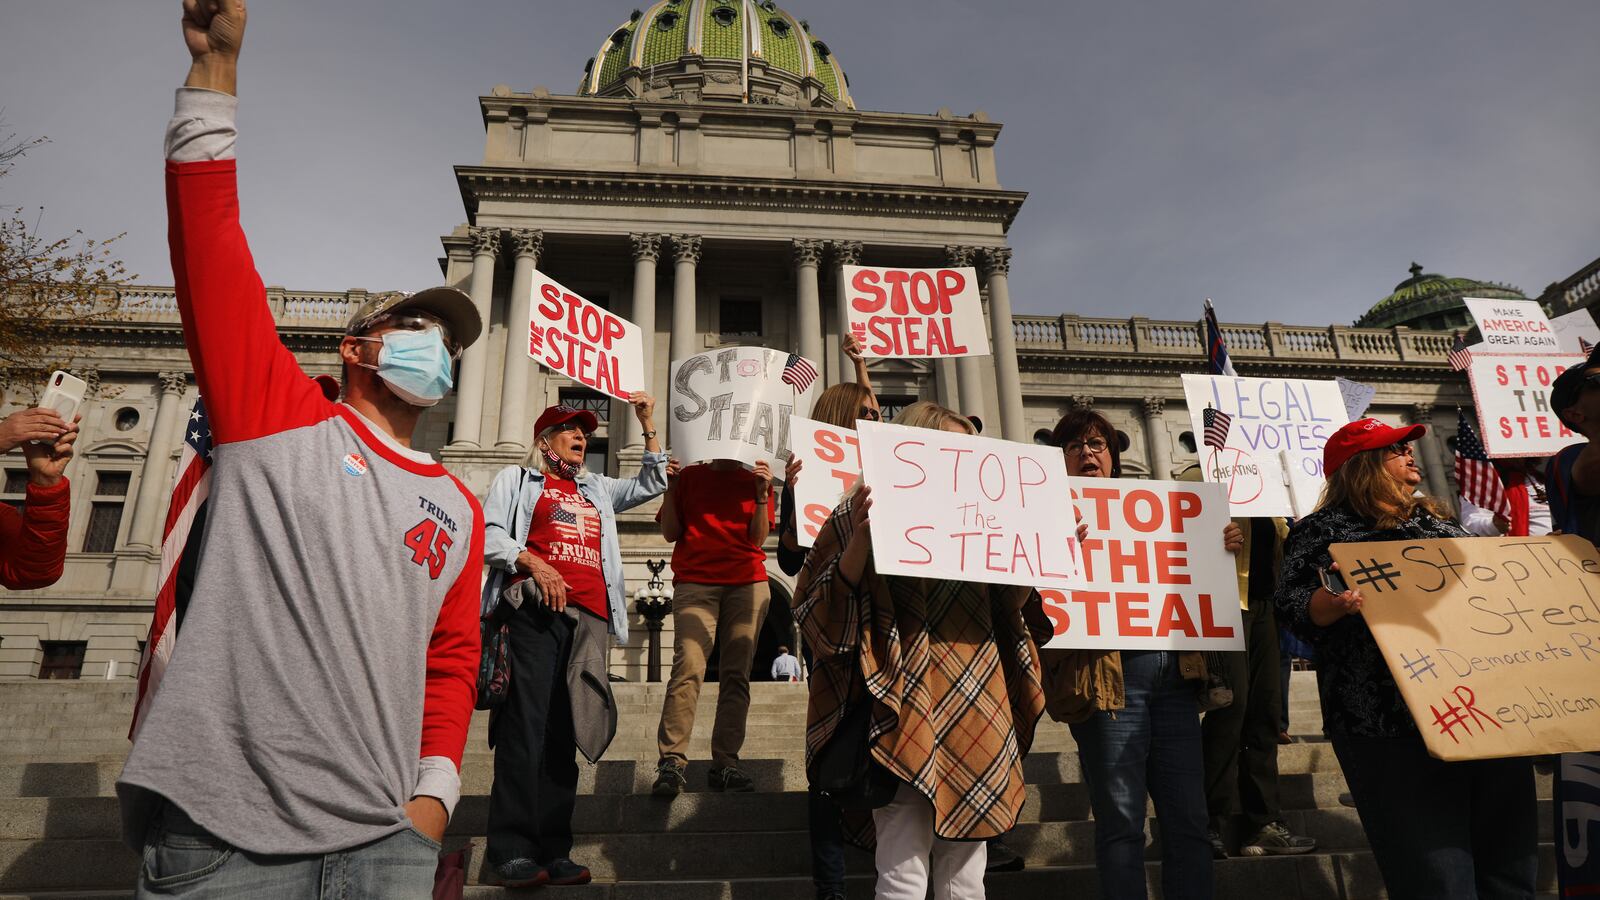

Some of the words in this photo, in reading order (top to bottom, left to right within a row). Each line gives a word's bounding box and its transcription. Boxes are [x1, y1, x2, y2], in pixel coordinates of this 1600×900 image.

[852, 269, 966, 315] STOP
[1492, 308, 1524, 317] MAKE
[538, 283, 625, 350] STOP
[868, 316, 968, 356] STEAL
[1483, 319, 1550, 333] AMERICA
[530, 320, 544, 356] THE
[1487, 335, 1521, 345] GREAT
[1523, 336, 1557, 346] AGAIN
[545, 327, 630, 400] STEAL
[1210, 377, 1332, 422] LEGAL
[1513, 390, 1549, 412] TH
[1240, 423, 1329, 451] VOTES
[1500, 416, 1585, 438] STEA
[894, 441, 1047, 508] STOP
[1212, 463, 1258, 479] CHEATING
[1069, 487, 1203, 533] TOP
[404, 518, 453, 580] 45
[549, 541, 600, 563] TRUM
[899, 526, 1079, 579] STEAL!
[1081, 539, 1192, 585] THE
[1039, 589, 1235, 638] STEAL
[1400, 642, 1571, 684] #Democrats
